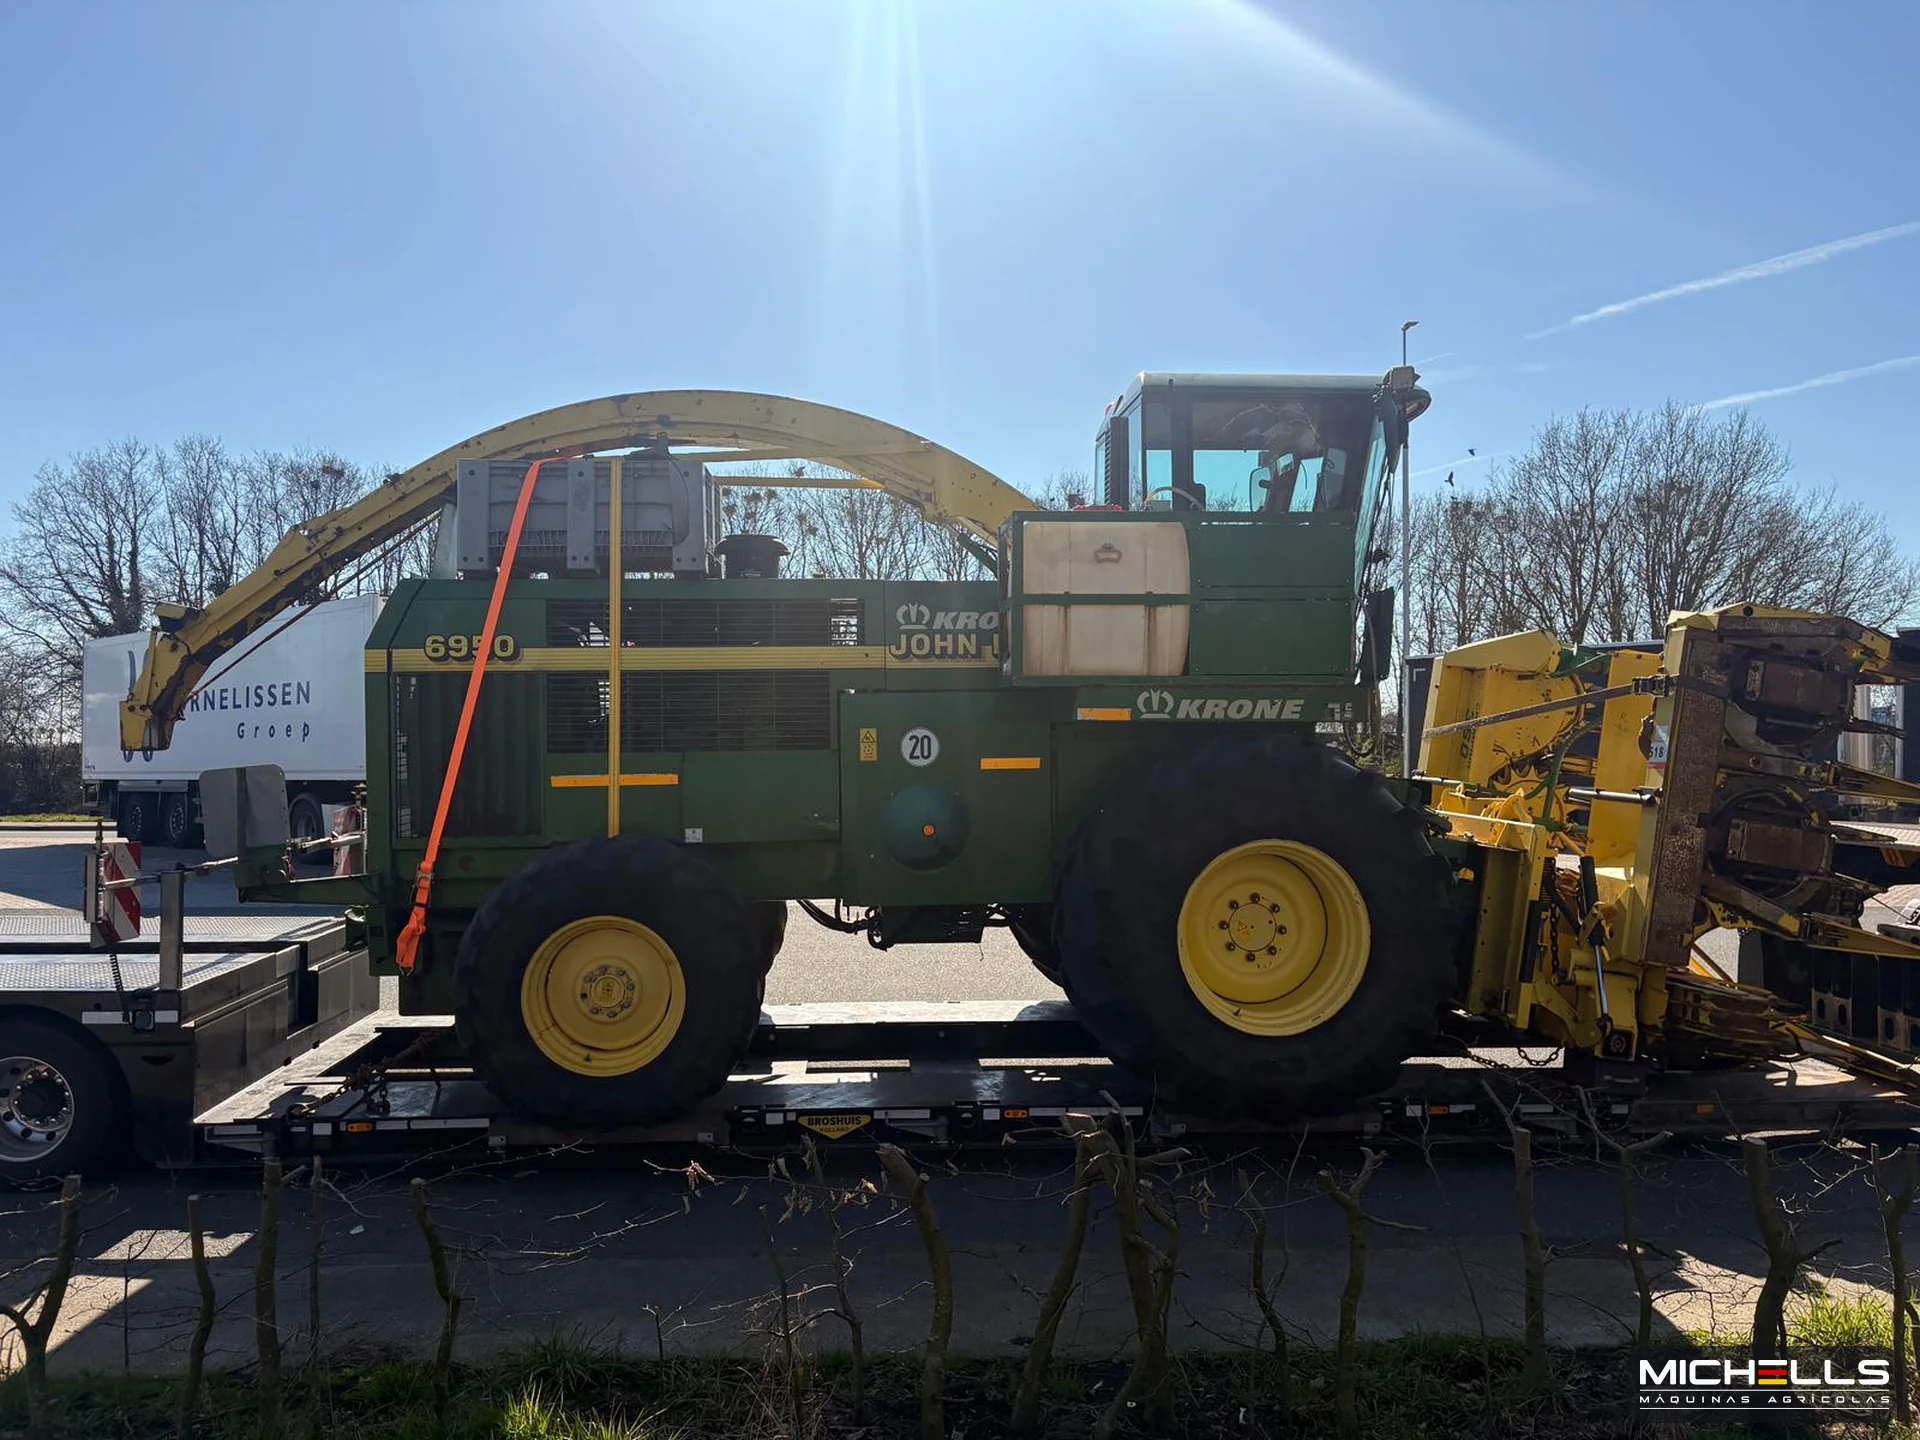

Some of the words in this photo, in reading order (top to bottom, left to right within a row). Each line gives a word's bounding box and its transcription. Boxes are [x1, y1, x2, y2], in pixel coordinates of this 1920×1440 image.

[932, 611, 999, 630] KRO
[889, 633, 977, 657] JOHN
[190, 681, 311, 712] RNELISSEN
[1175, 699, 1304, 720] KRONE
[236, 721, 310, 743] Groep
[908, 734, 932, 760] 20
[807, 1115, 862, 1127] BROSHUIS
